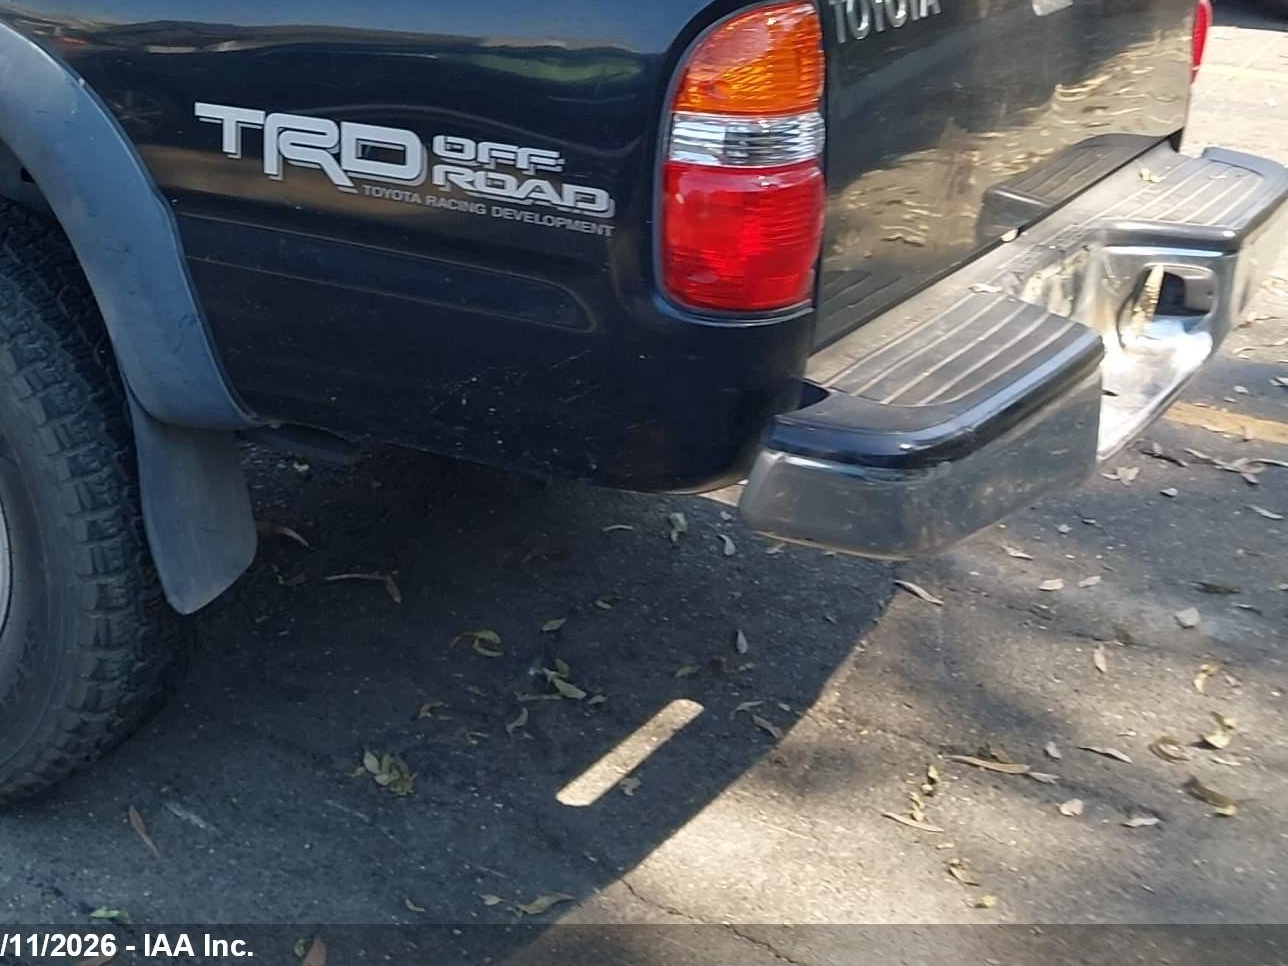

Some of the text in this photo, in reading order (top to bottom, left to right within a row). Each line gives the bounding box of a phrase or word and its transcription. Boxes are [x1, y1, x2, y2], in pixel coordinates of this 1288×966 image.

[194, 102, 428, 193] TRD
[432, 135, 565, 176] OFF
[362, 185, 616, 237] TOYOTA RACING DEVELOPMENT
[432, 164, 616, 219] ROAD
